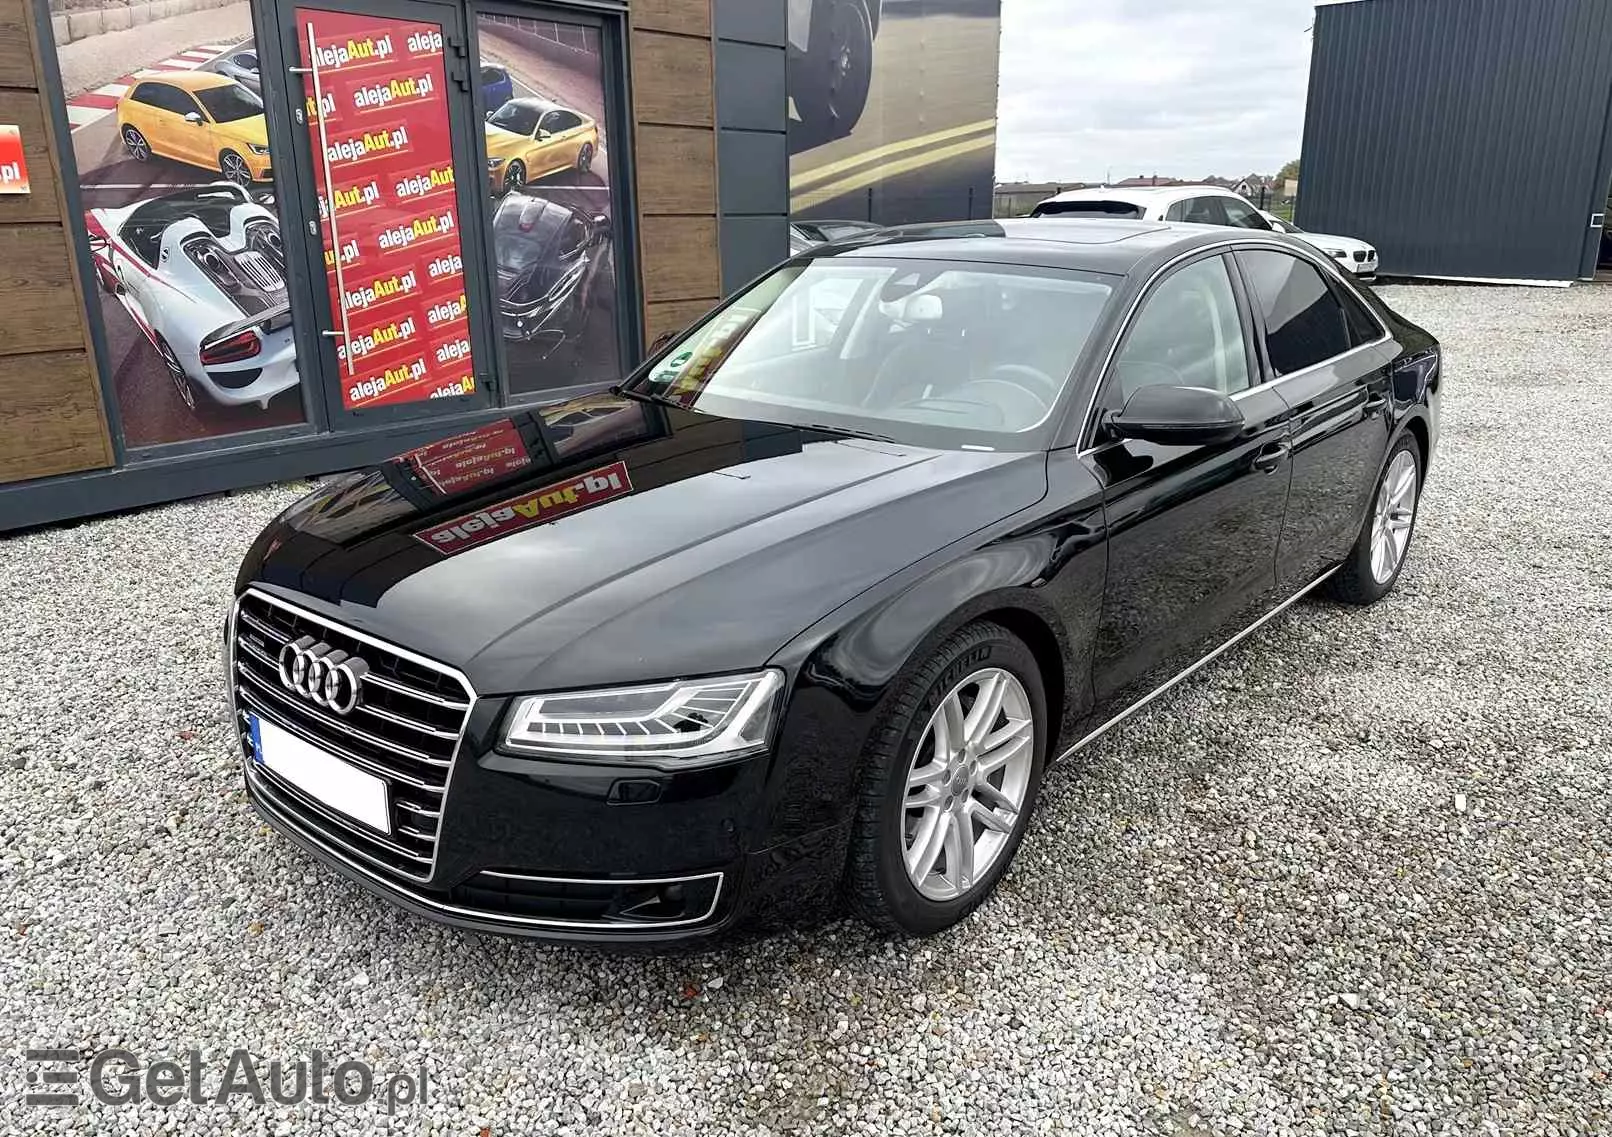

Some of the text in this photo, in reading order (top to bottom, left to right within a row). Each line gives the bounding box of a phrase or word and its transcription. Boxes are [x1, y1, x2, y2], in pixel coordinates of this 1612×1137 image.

[308, 35, 393, 69] lejaAut.pl
[353, 74, 433, 107] alejaAut.pl
[327, 126, 409, 162] alejaAut.pl
[395, 166, 455, 198] alejaAut
[378, 211, 455, 249] alejaAut.pl
[428, 254, 463, 278] aleja
[337, 270, 417, 310] lejaAut.pl
[336, 316, 416, 360] aejaAut.pl
[349, 358, 427, 402] alejaAut.pl
